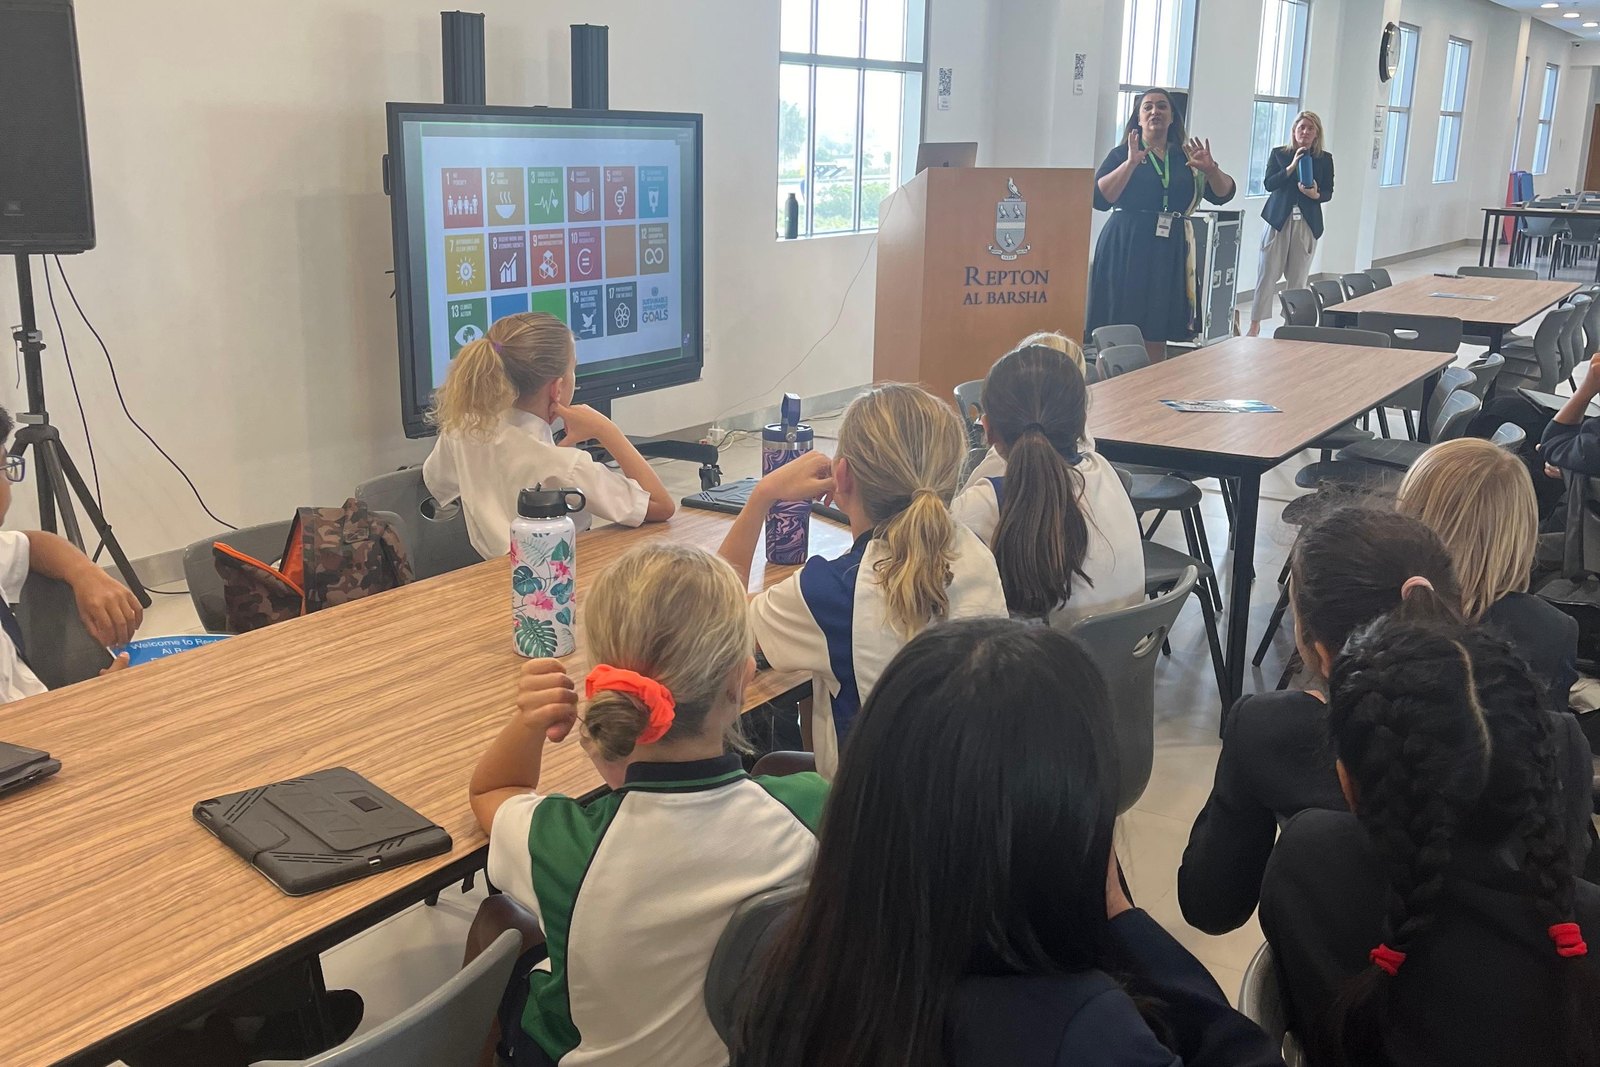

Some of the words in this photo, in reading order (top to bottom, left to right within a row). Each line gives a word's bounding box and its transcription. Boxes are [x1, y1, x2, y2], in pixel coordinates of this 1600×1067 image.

[490, 171, 496, 185] 2
[530, 171, 536, 184] 3
[570, 170, 575, 182] 4
[606, 170, 611, 182] 5
[571, 232, 578, 245] 10
[641, 228, 647, 239] 12
[449, 240, 454, 252] 7
[492, 237, 498, 250] 8
[532, 235, 538, 247] 9
[964, 266, 1050, 286] REPTON
[572, 291, 580, 304] 16
[608, 287, 615, 299] 17
[963, 292, 982, 305] AL
[986, 291, 1047, 304] BARSHA
[451, 304, 460, 318] 13
[642, 309, 669, 323] GOALS
[130, 639, 180, 650] Welcome
